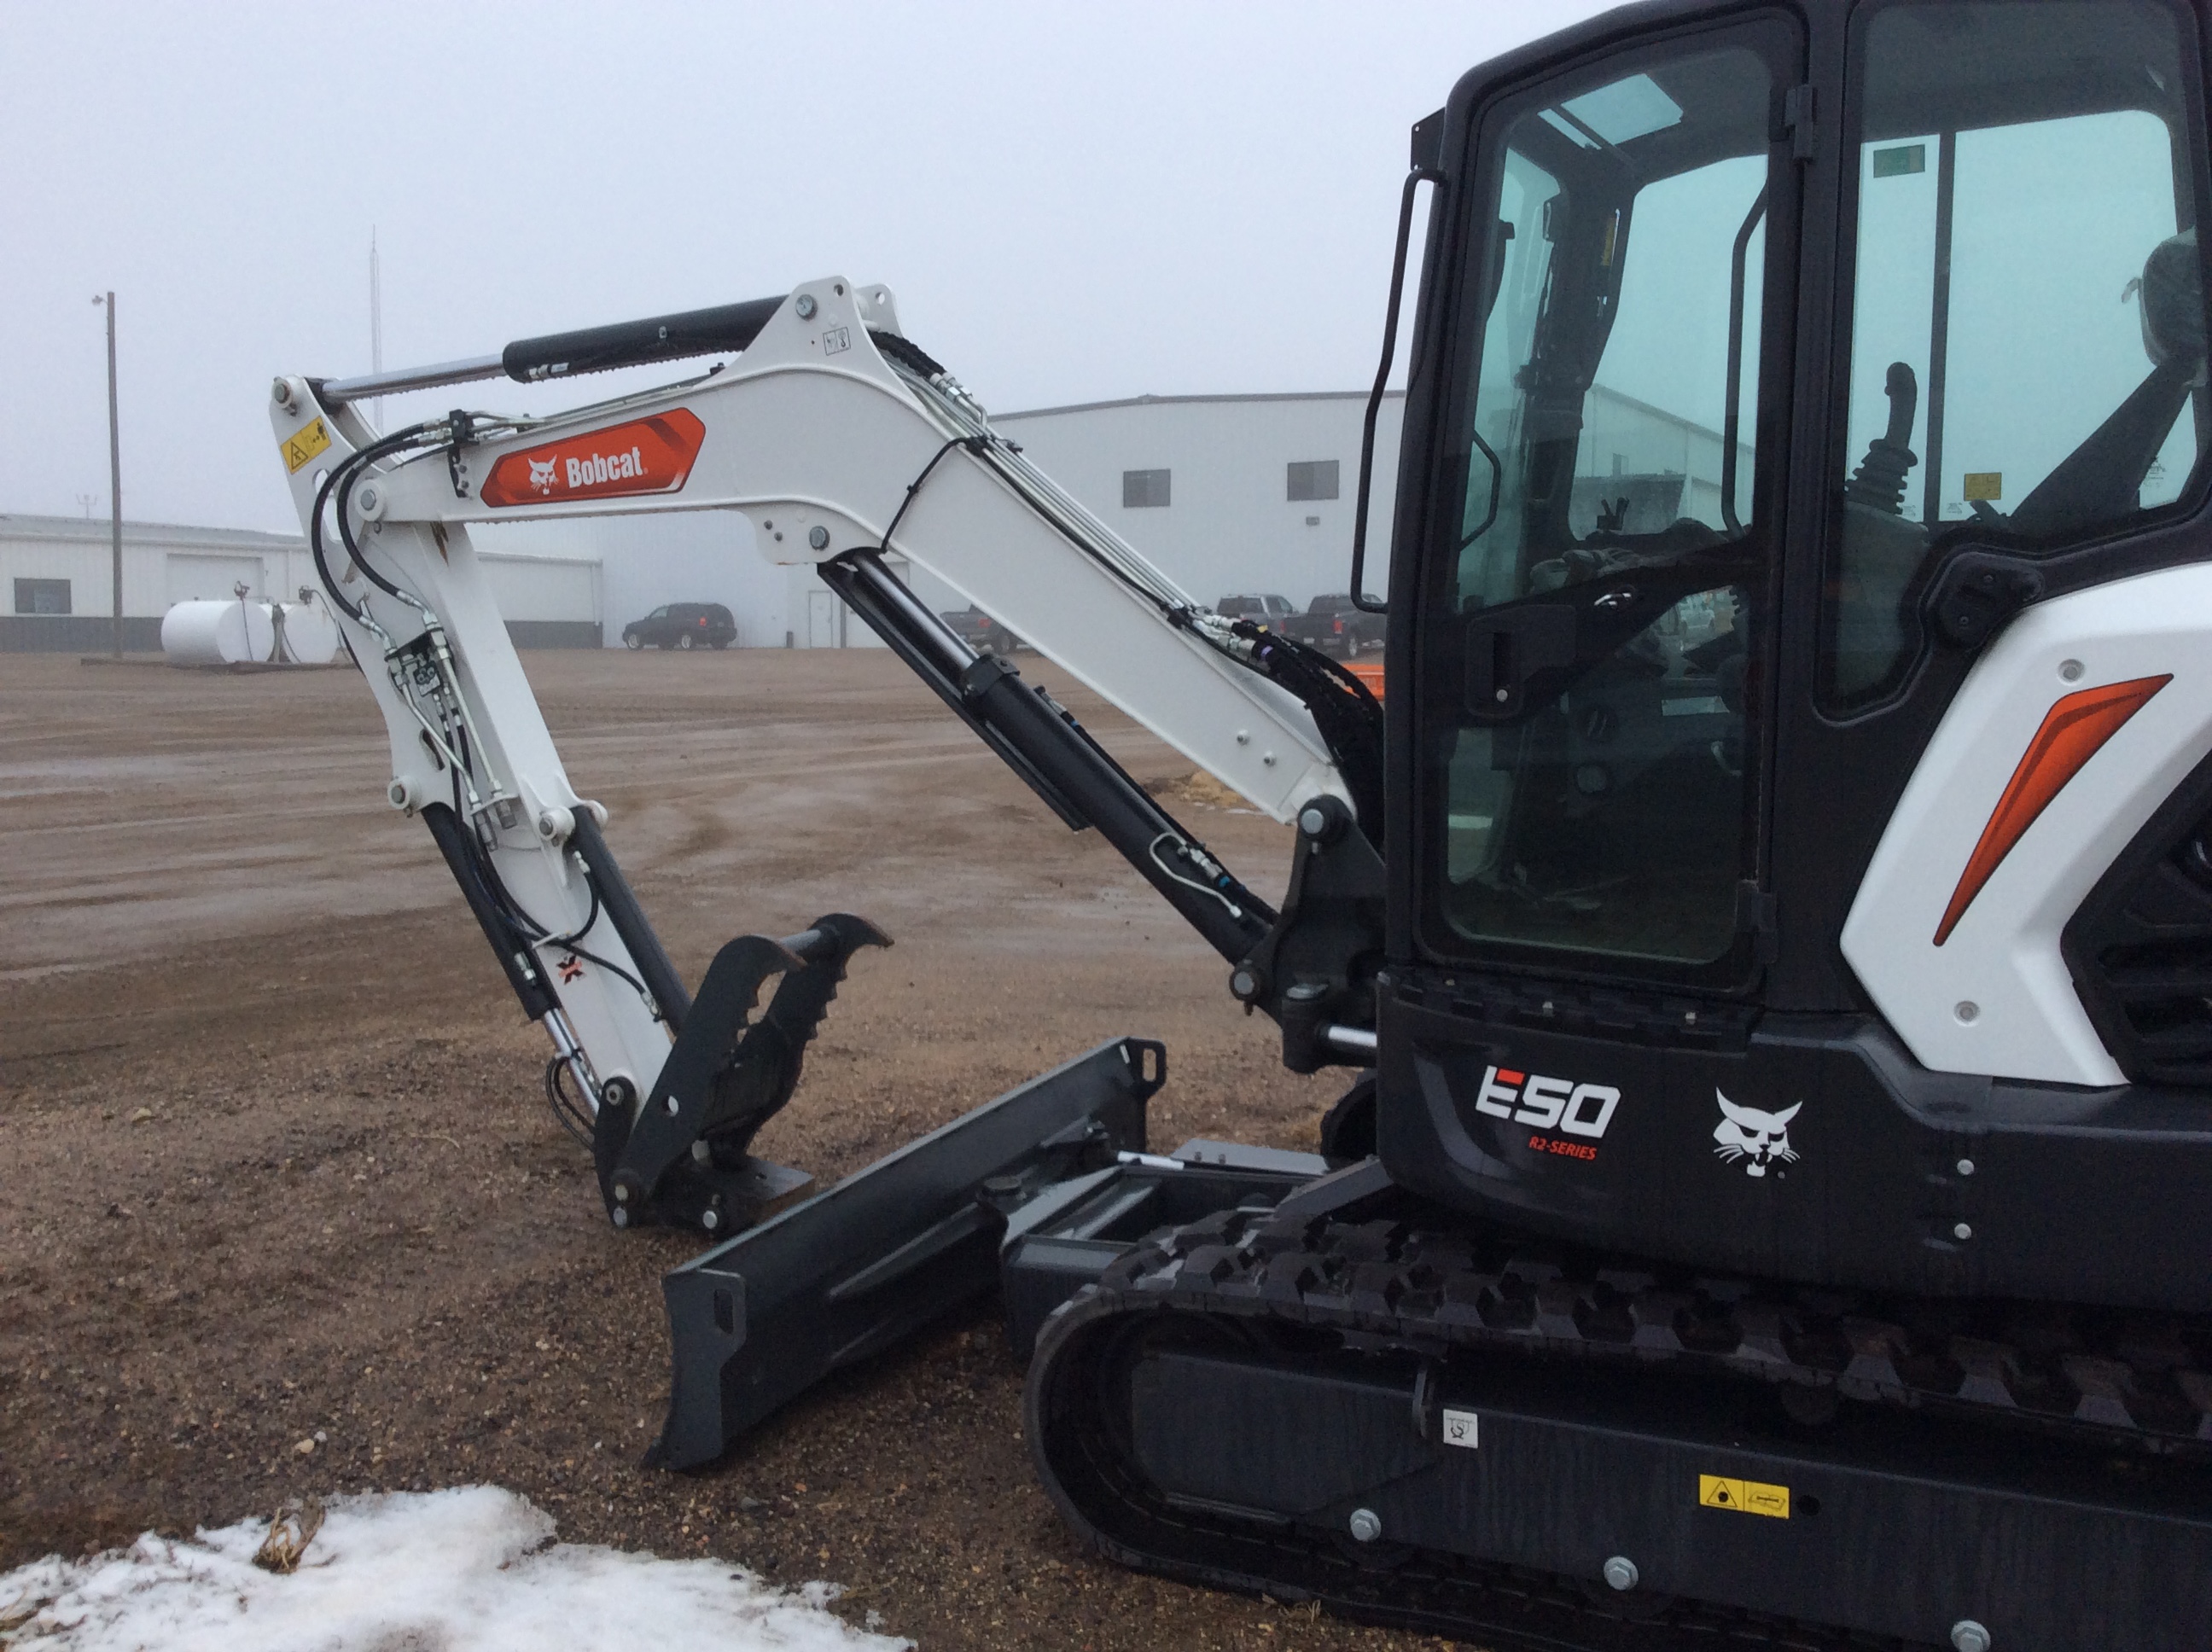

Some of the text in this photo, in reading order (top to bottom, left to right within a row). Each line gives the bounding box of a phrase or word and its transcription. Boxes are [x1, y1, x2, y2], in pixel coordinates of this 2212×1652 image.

[566, 446, 643, 488] Bobcat
[1476, 1065, 1621, 1138] E50
[1528, 1136, 1598, 1160] R2-SERIES
